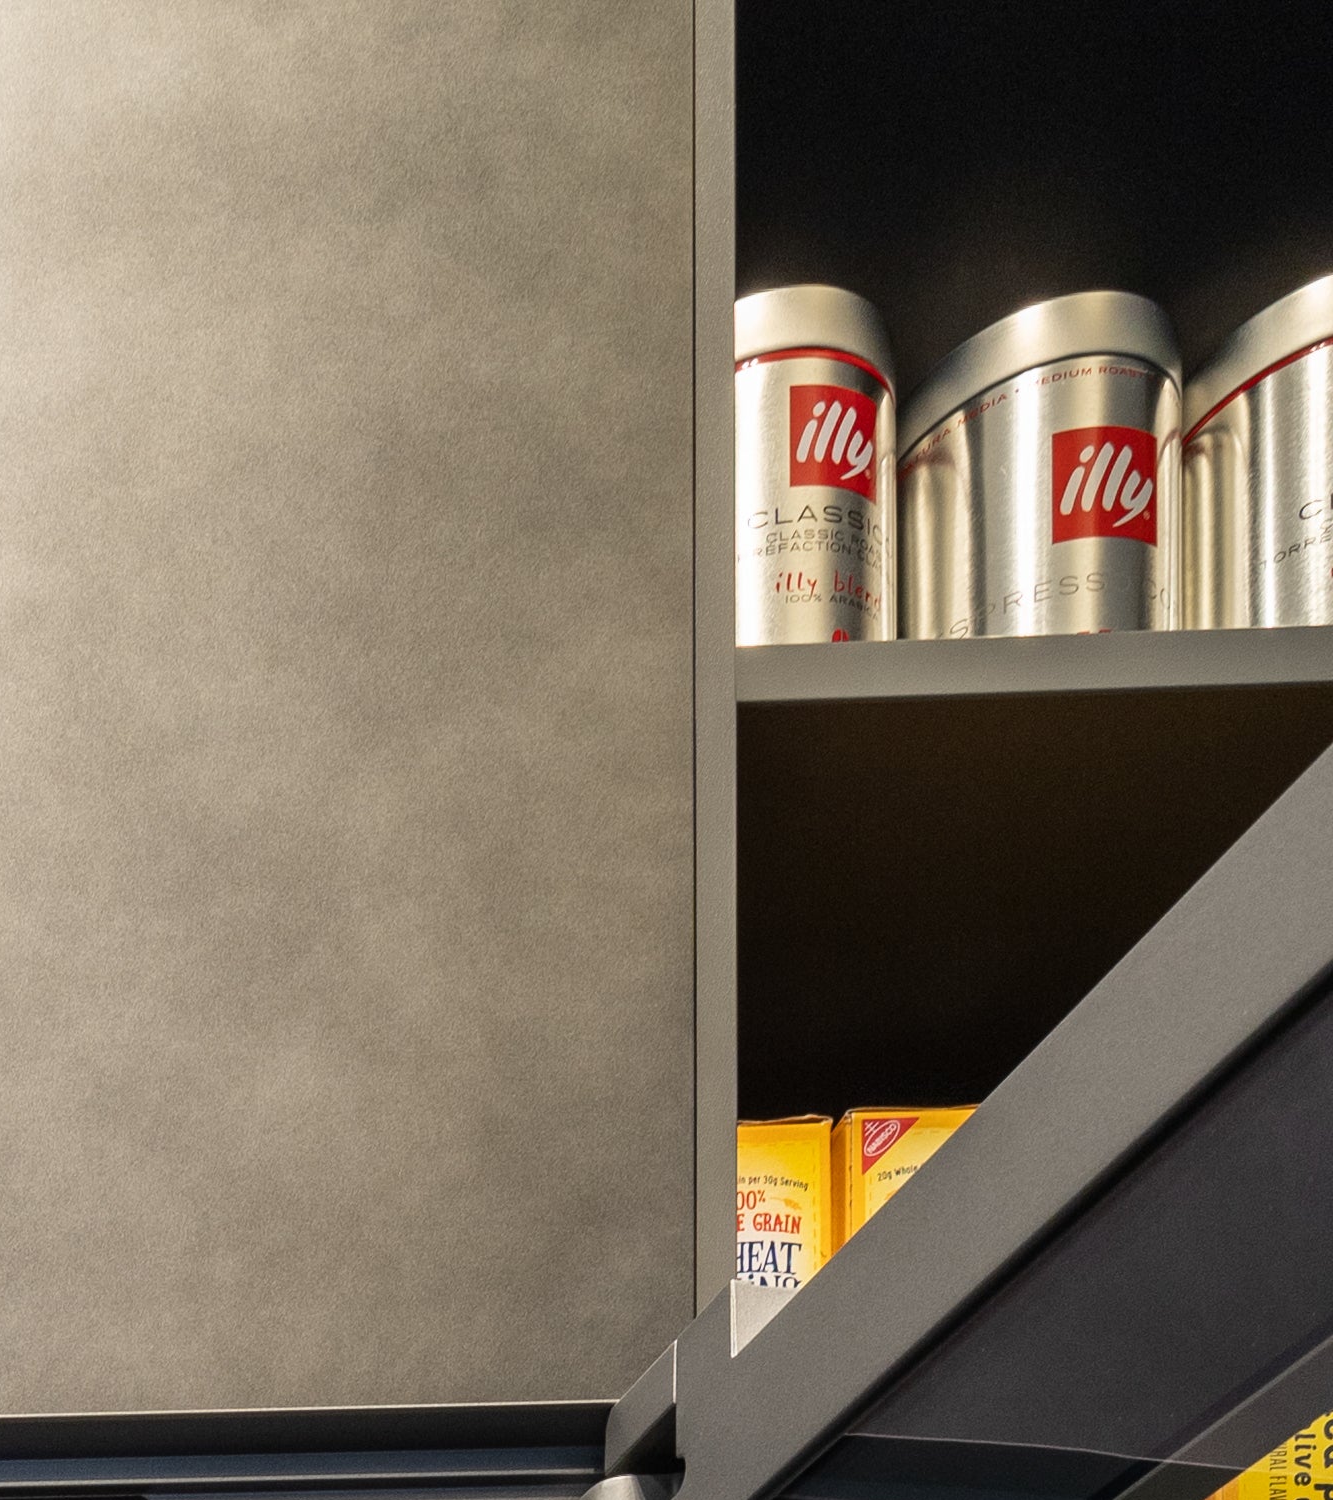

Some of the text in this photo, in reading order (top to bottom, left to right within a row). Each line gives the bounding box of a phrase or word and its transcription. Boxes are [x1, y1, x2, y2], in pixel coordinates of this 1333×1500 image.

[796, 400, 873, 480] illy
[1060, 442, 1153, 527] illy
[776, 571, 817, 597] illy
[764, 1176, 808, 1191] 30g Serving
[753, 1214, 801, 1234] GRAIN
